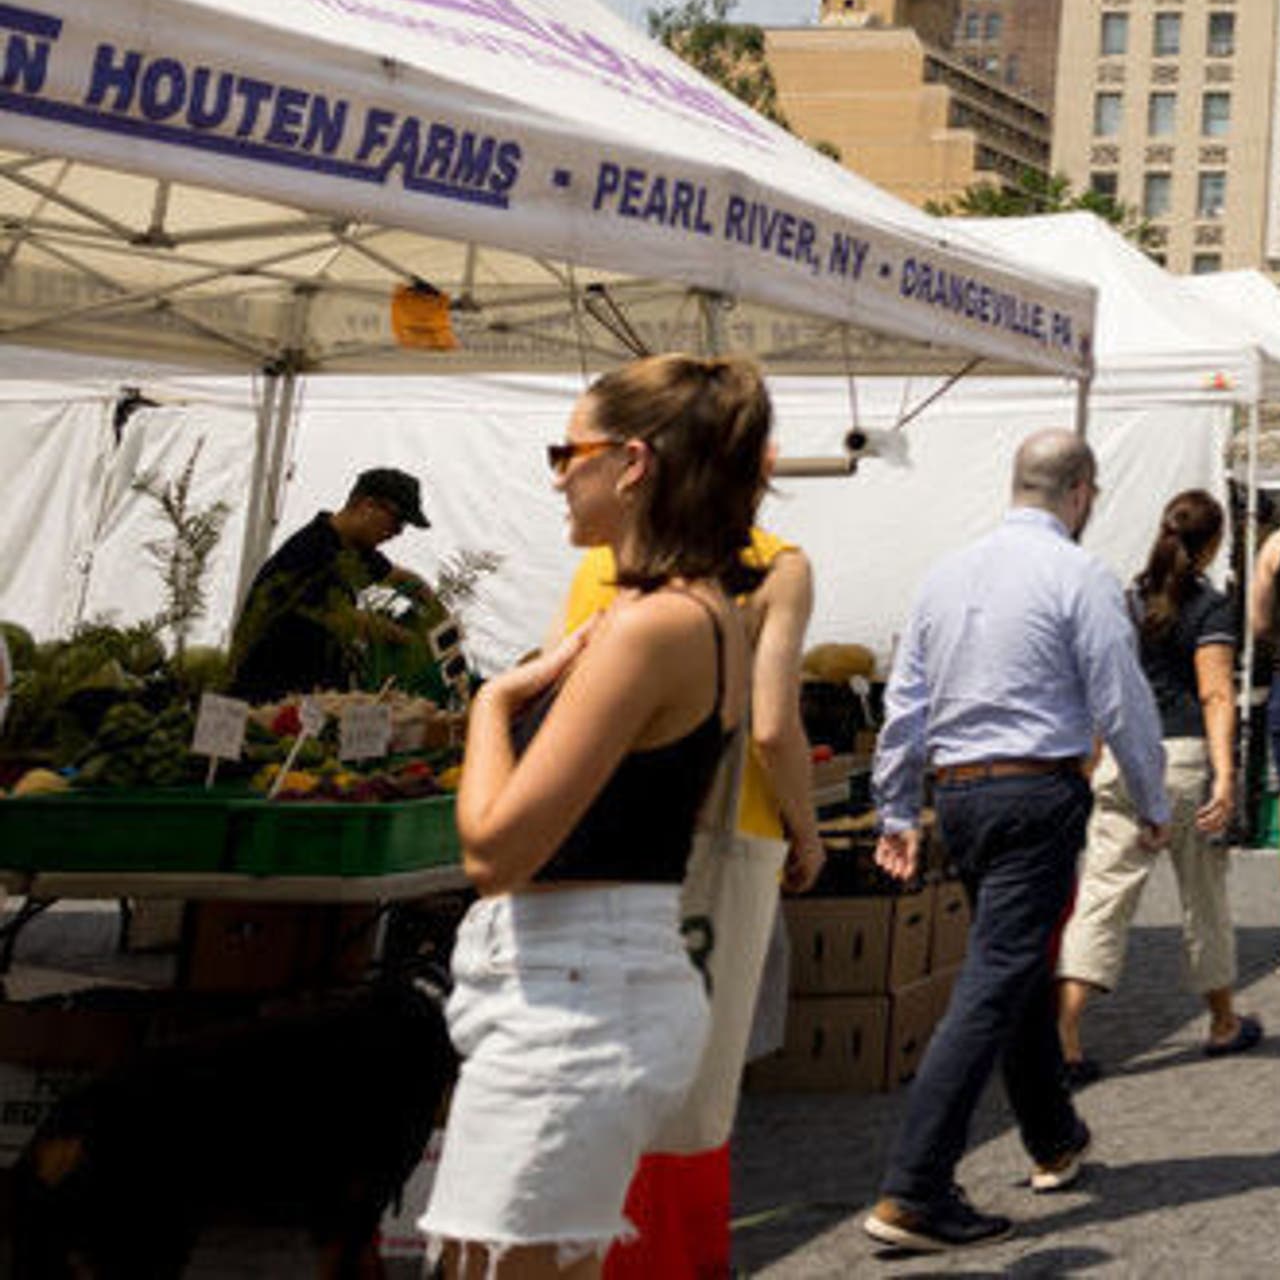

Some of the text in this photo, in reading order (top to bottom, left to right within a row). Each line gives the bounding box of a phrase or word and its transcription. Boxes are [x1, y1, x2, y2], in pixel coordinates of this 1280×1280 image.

[84, 43, 349, 155] HOUTEN
[354, 106, 523, 191] FARMS
[593, 162, 714, 233] PEARL
[725, 195, 822, 276] RIVER,
[828, 232, 871, 280] NY
